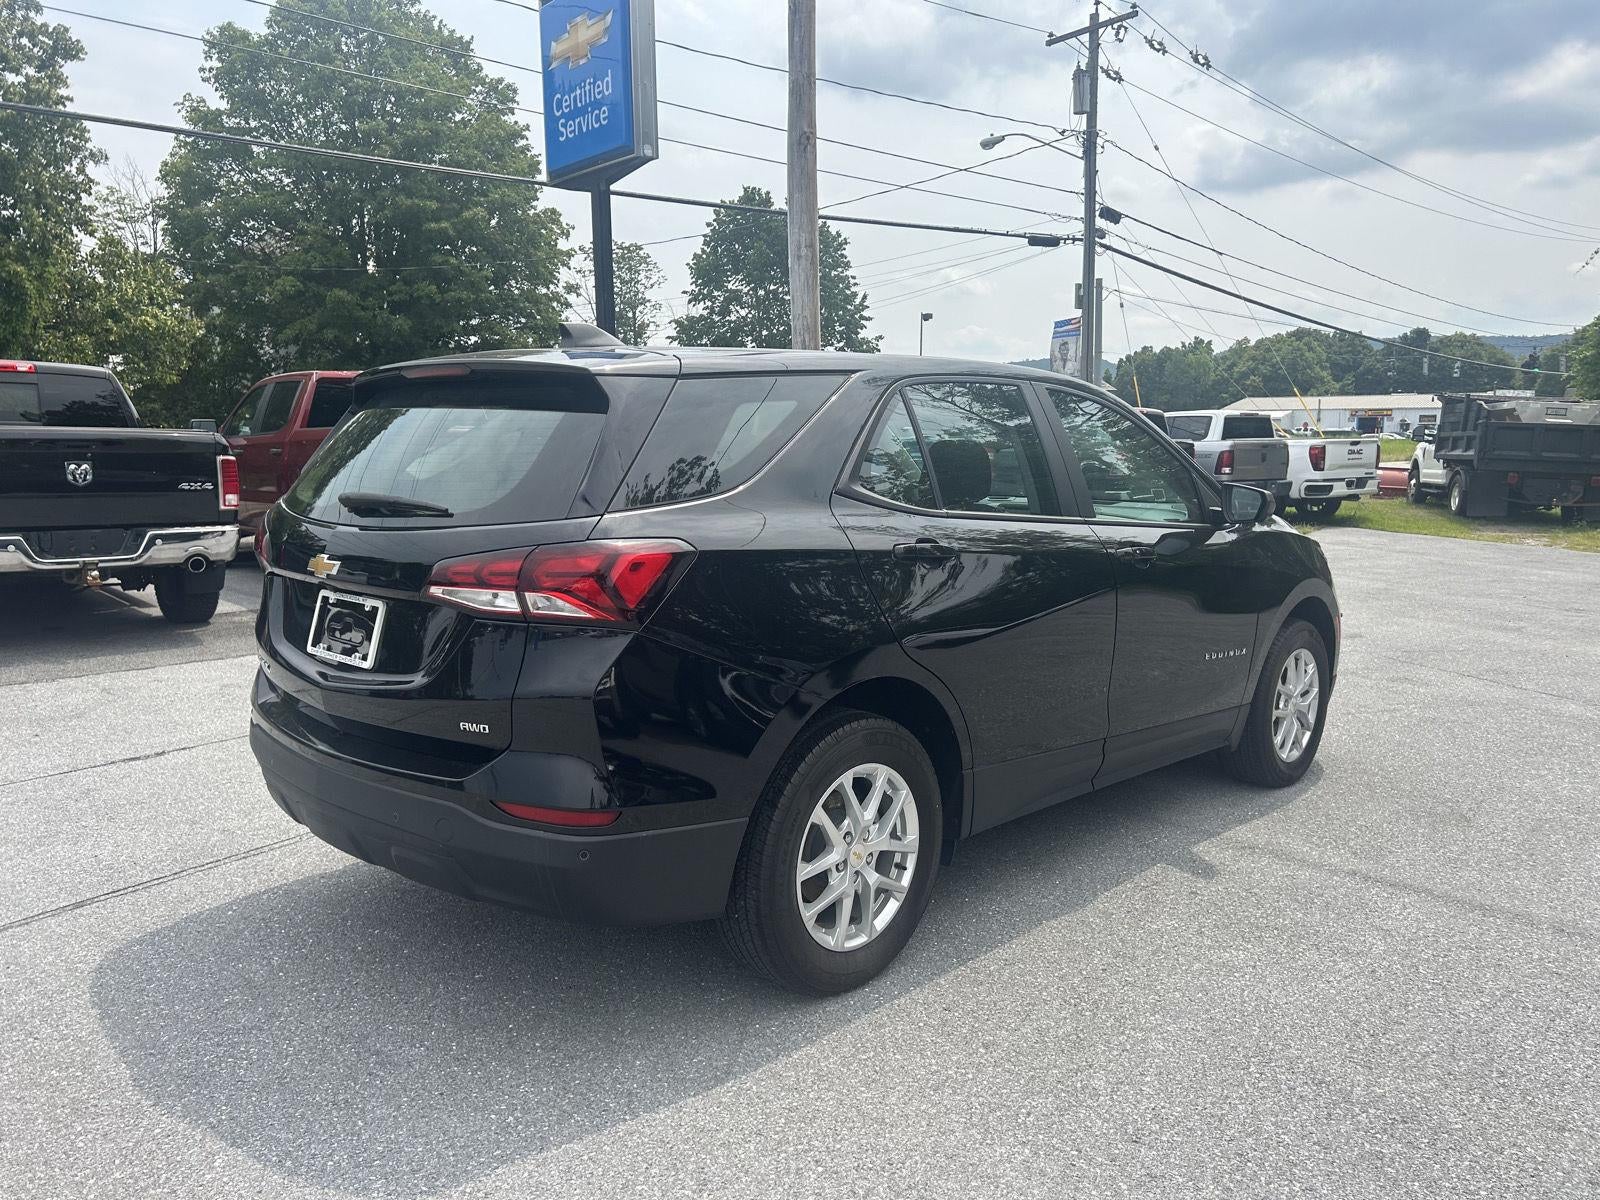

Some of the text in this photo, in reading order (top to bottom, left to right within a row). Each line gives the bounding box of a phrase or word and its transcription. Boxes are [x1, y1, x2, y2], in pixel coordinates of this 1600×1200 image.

[553, 69, 612, 117] Certified
[558, 106, 609, 142] Service
[1205, 648, 1247, 660] EQUINOX
[460, 722, 490, 733] AWD
